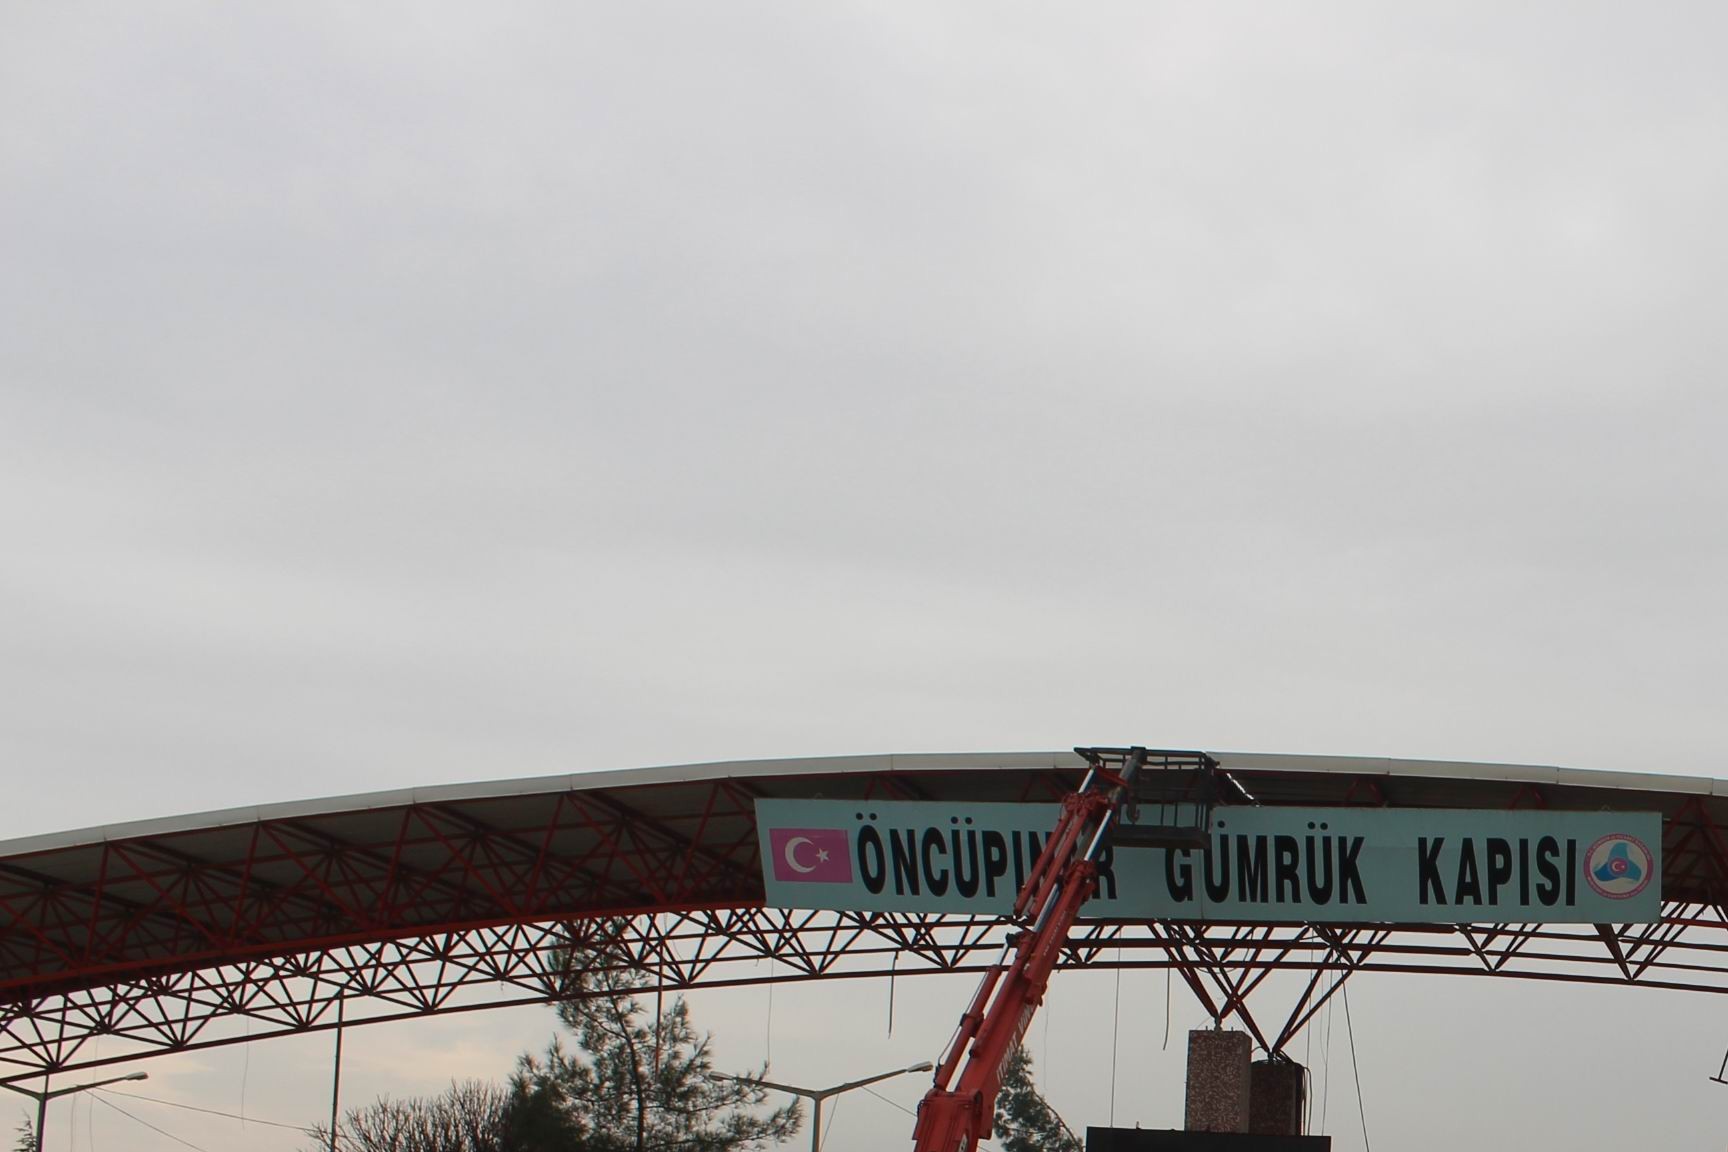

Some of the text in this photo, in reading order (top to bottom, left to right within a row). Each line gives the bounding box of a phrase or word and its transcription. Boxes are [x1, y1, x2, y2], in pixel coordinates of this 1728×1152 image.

[856, 812, 1118, 900] ÖNCÜPINR
[1164, 821, 1368, 906] GÜMRÜK
[1417, 835, 1577, 907] KAPISI
